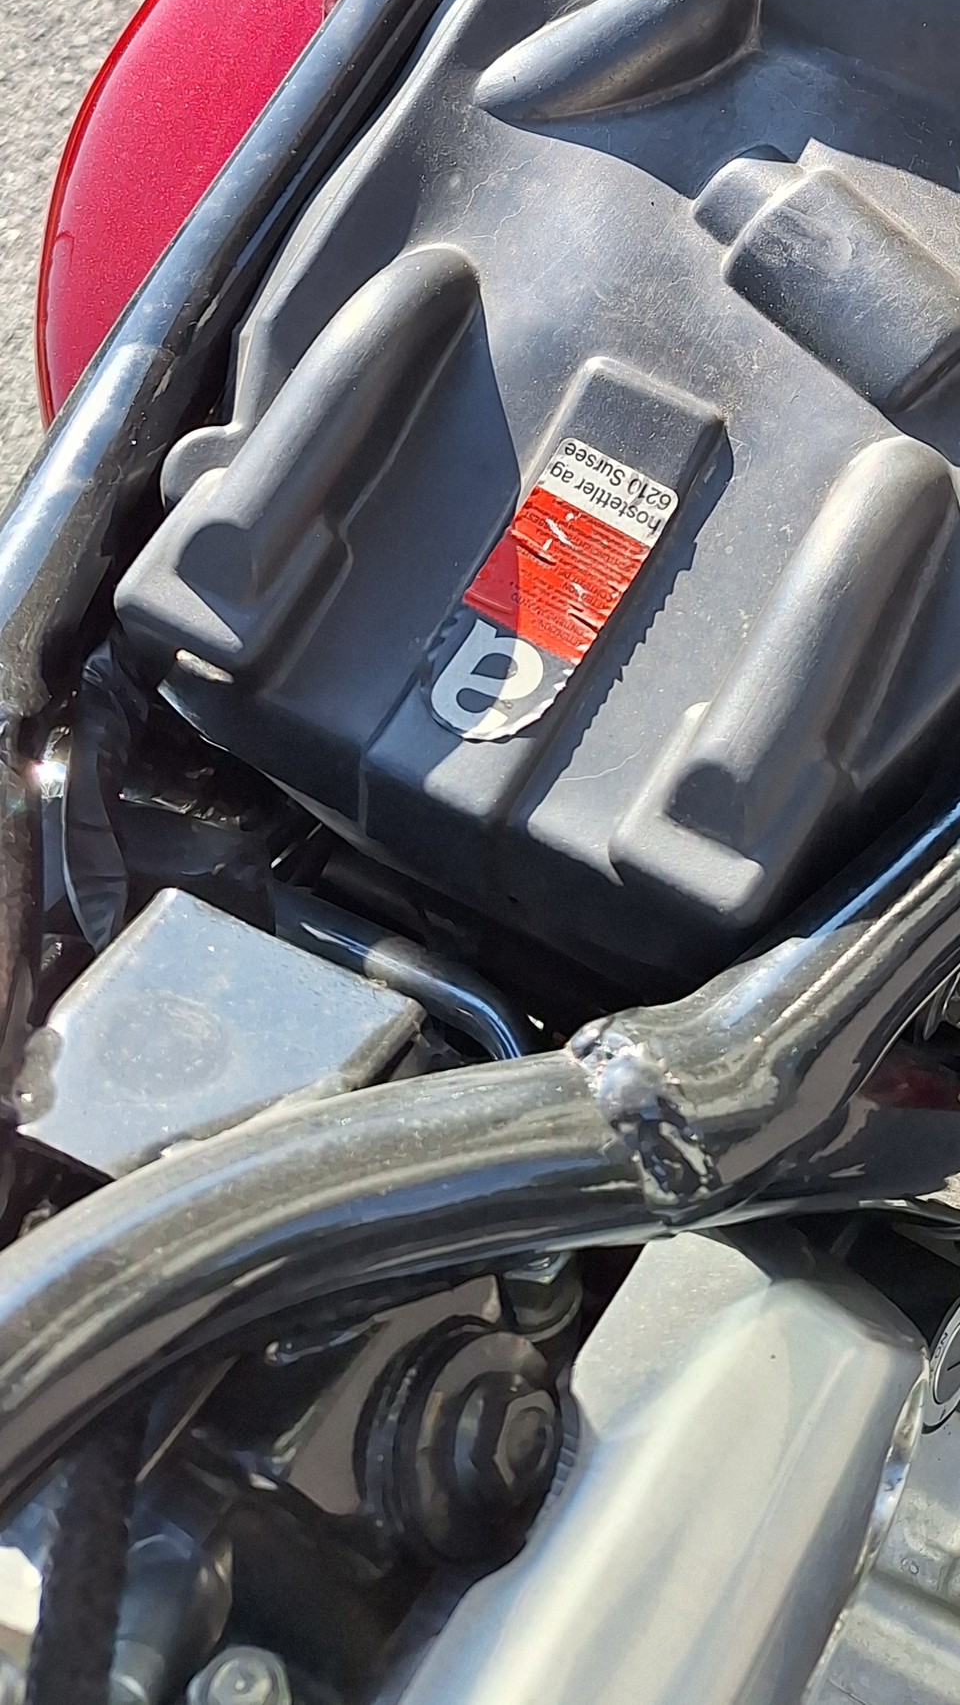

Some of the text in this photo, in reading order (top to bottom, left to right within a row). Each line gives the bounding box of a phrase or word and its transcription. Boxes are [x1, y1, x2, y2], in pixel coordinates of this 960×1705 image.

[550, 461, 574, 484] ag
[564, 442, 671, 510] 6210 Sursee
[573, 475, 662, 534] hostettler
